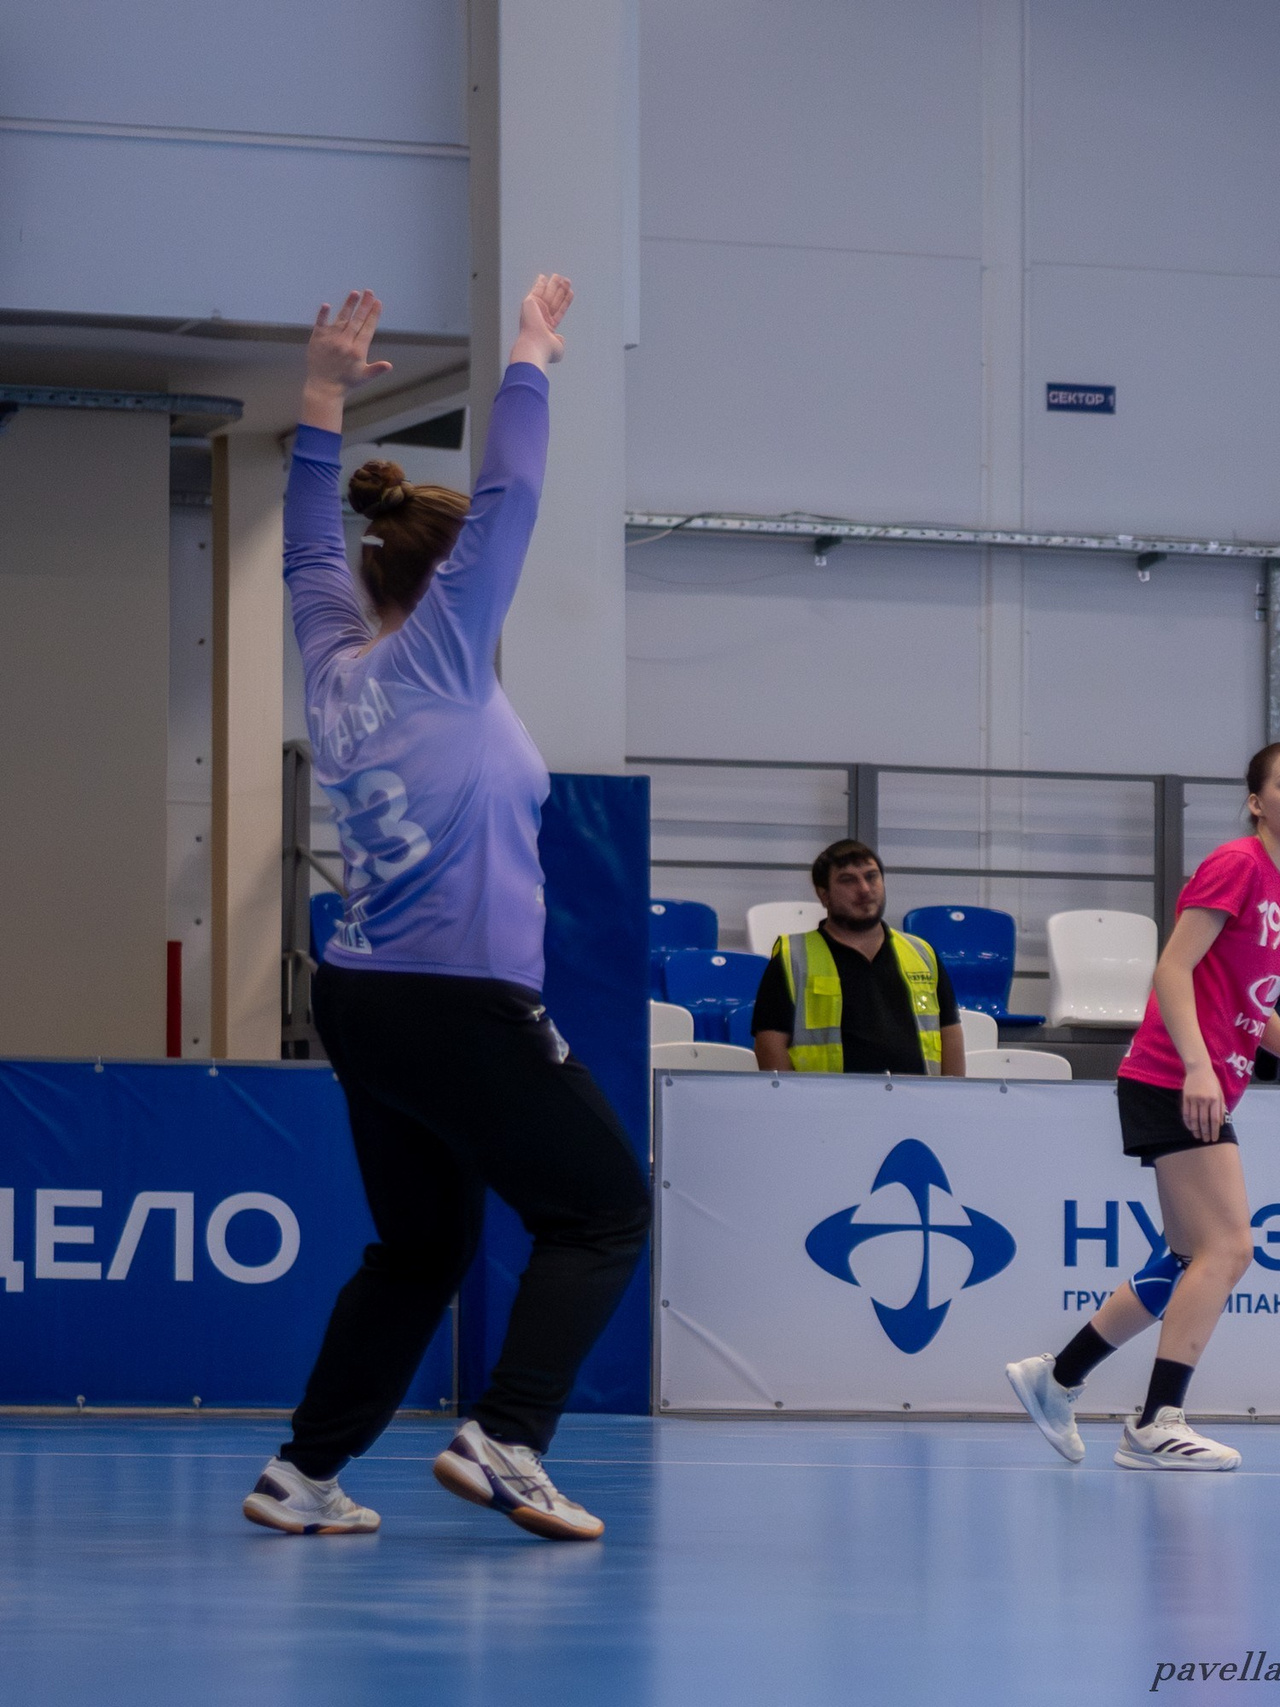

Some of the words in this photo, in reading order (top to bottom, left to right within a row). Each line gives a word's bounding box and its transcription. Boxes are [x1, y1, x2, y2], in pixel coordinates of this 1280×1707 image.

[1049, 391, 1105, 406] СЕКТОР
[0, 1187, 301, 1292] ЕЛО
[1063, 1289, 1115, 1311] ГРУ
